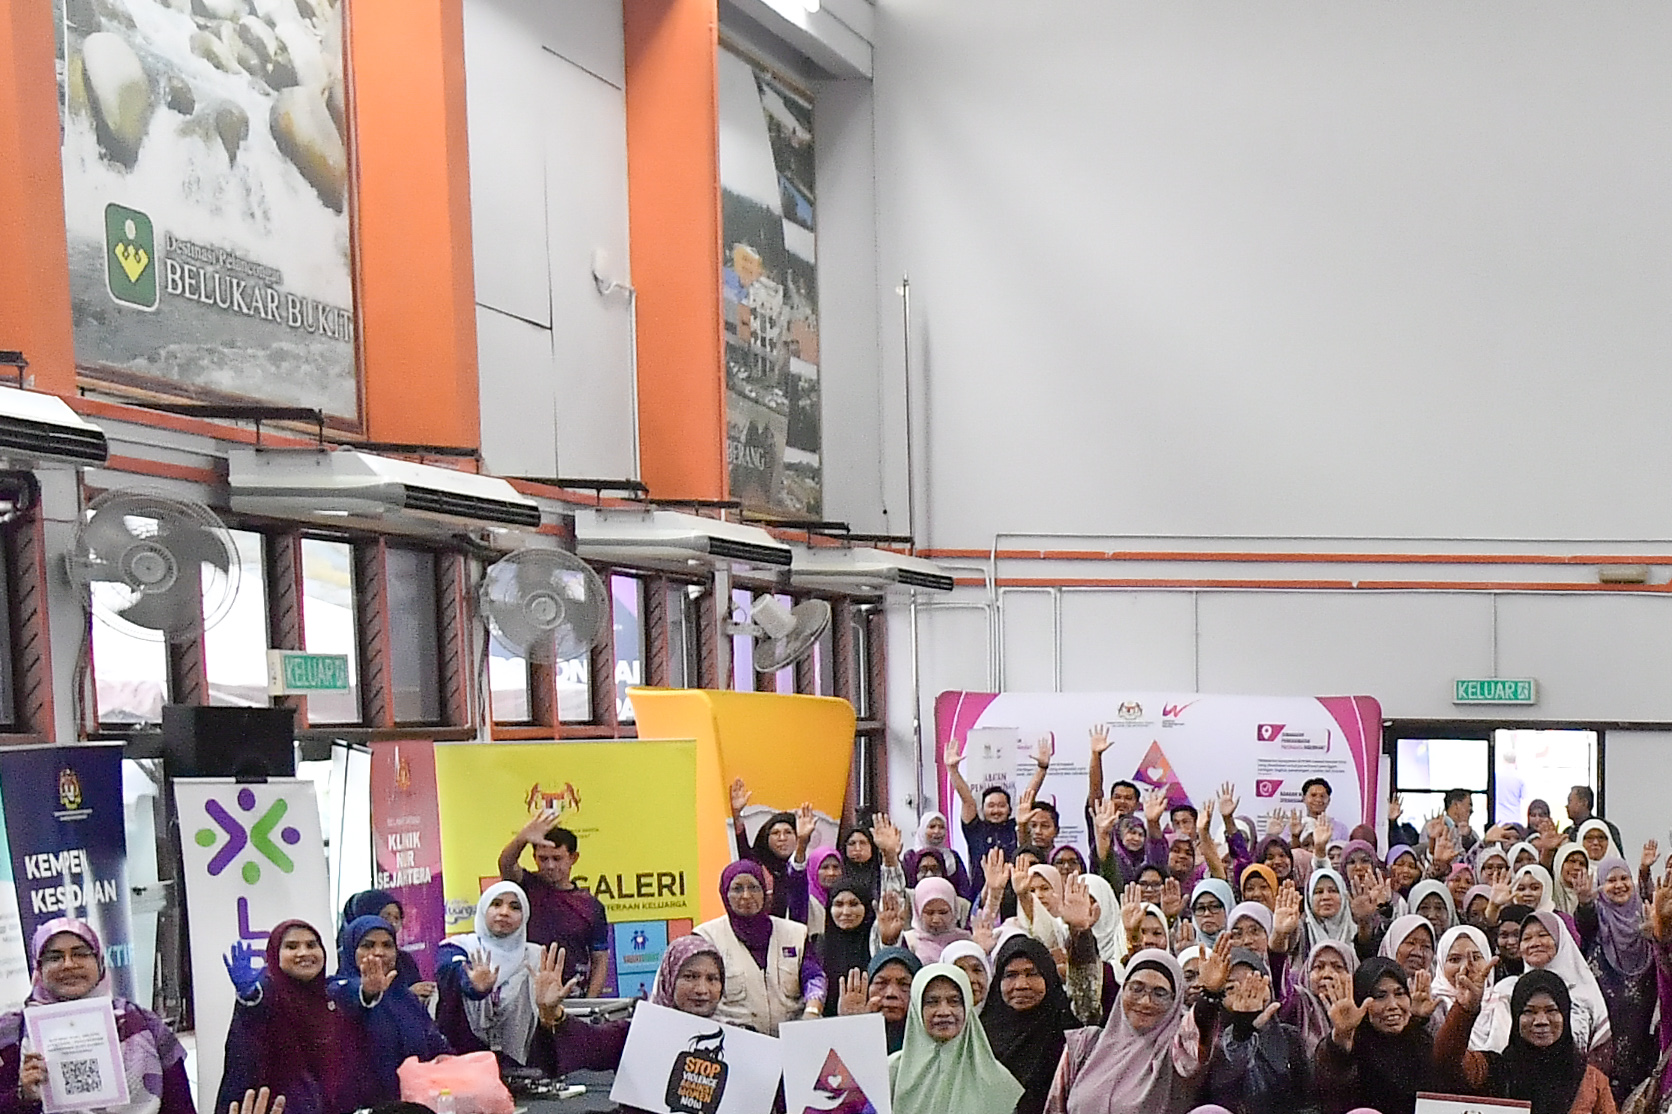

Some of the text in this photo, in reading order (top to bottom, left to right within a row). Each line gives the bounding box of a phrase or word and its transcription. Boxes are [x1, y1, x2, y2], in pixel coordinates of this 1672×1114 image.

[165, 257, 353, 342] BELUKAR BUKIT
[285, 656, 331, 688] KELUAR
[1456, 679, 1516, 700] KELUAR
[641, 900, 688, 911] KELUARGA
[685, 1056, 721, 1078] STOP
[682, 1071, 718, 1088] VIOLENCE
[681, 1096, 703, 1109] NOW
